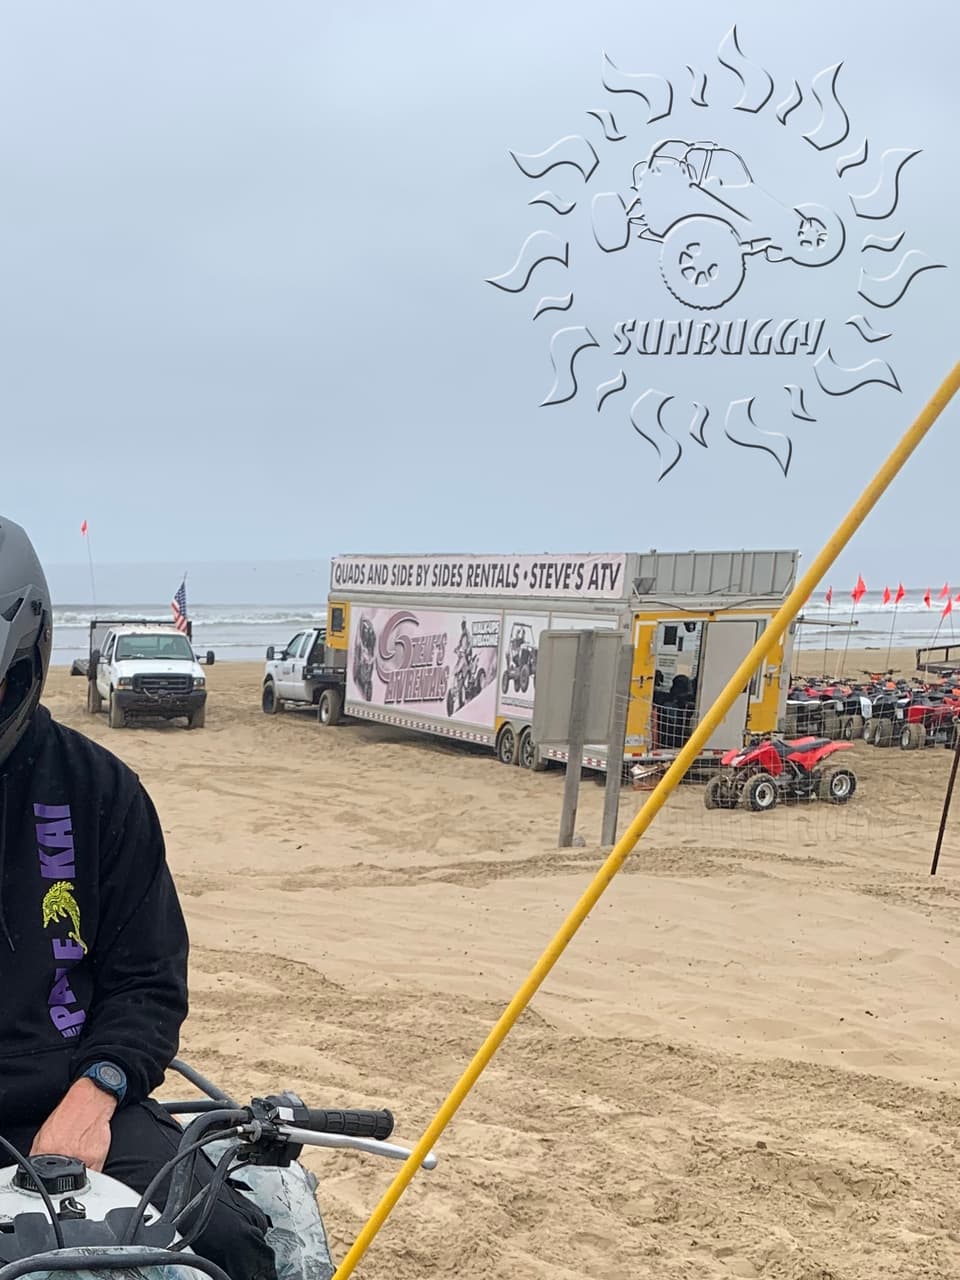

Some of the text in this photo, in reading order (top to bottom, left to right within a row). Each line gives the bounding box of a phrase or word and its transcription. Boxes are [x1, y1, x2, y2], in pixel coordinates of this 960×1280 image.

[334, 562, 622, 591] QUADS AND SIDE BY SIDES RENTALS STEVE'S ATV
[33, 803, 77, 879] KAI
